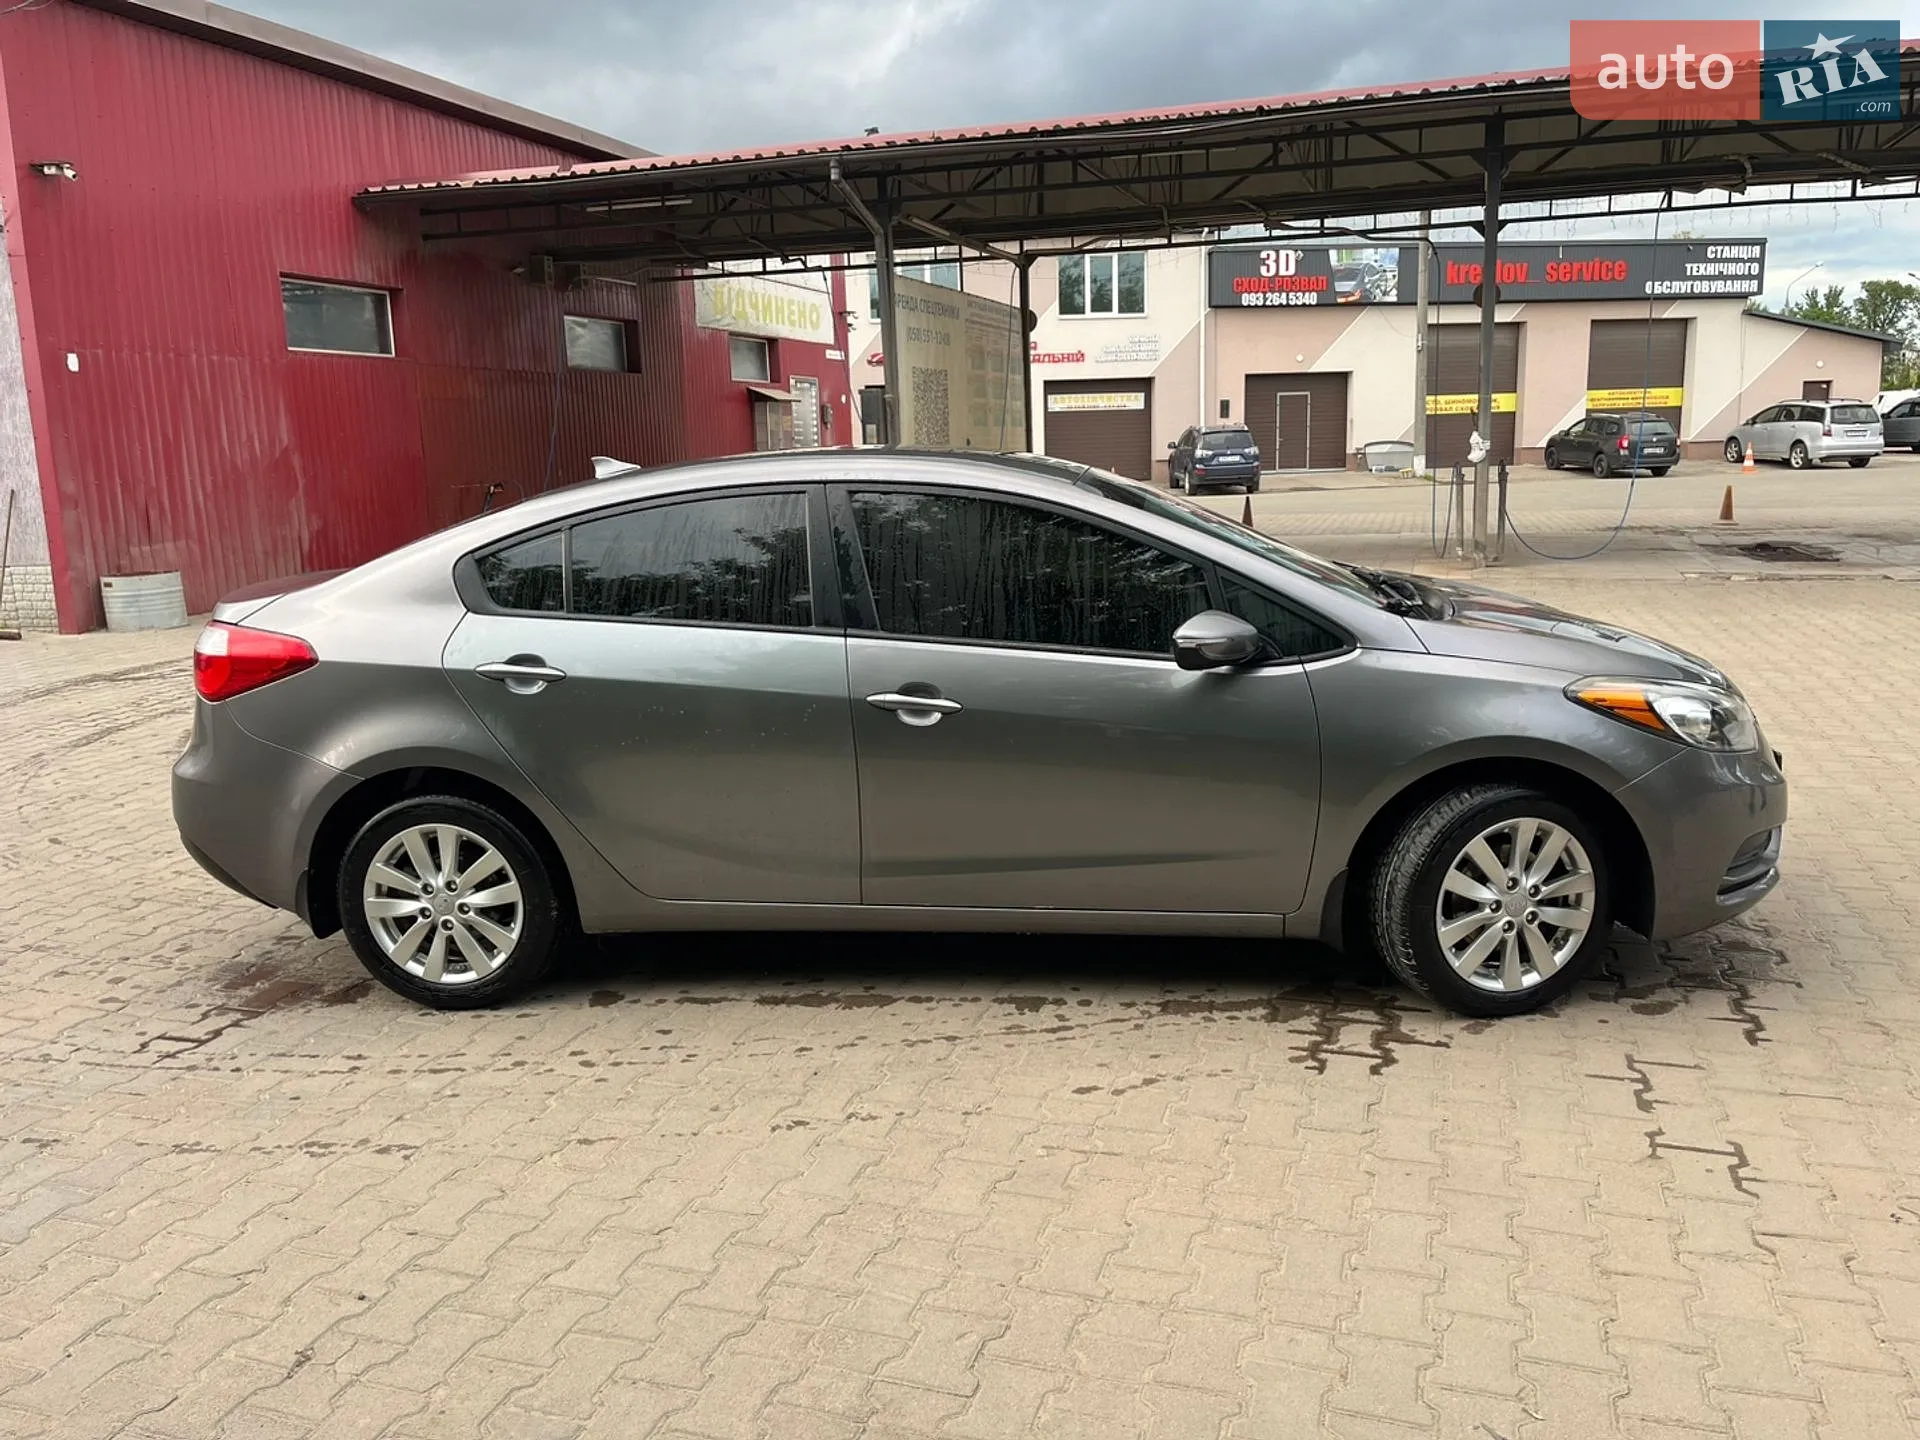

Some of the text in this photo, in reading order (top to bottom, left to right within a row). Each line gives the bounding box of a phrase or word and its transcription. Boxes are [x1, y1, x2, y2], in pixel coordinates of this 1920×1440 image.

[1706, 245, 1761, 260] СТАНЦІЯ
[1446, 258, 1629, 284] krelov_ service
[1684, 262, 1760, 276] ТЕХНІЧНОГО
[1232, 276, 1329, 294] СХОД-РОЗВАЛ
[1645, 280, 1758, 294] ОБСЛУГОВУВАННЯ
[1241, 292, 1318, 306] 093 264 5340
[712, 283, 821, 331] ВІДЧИНЕНО
